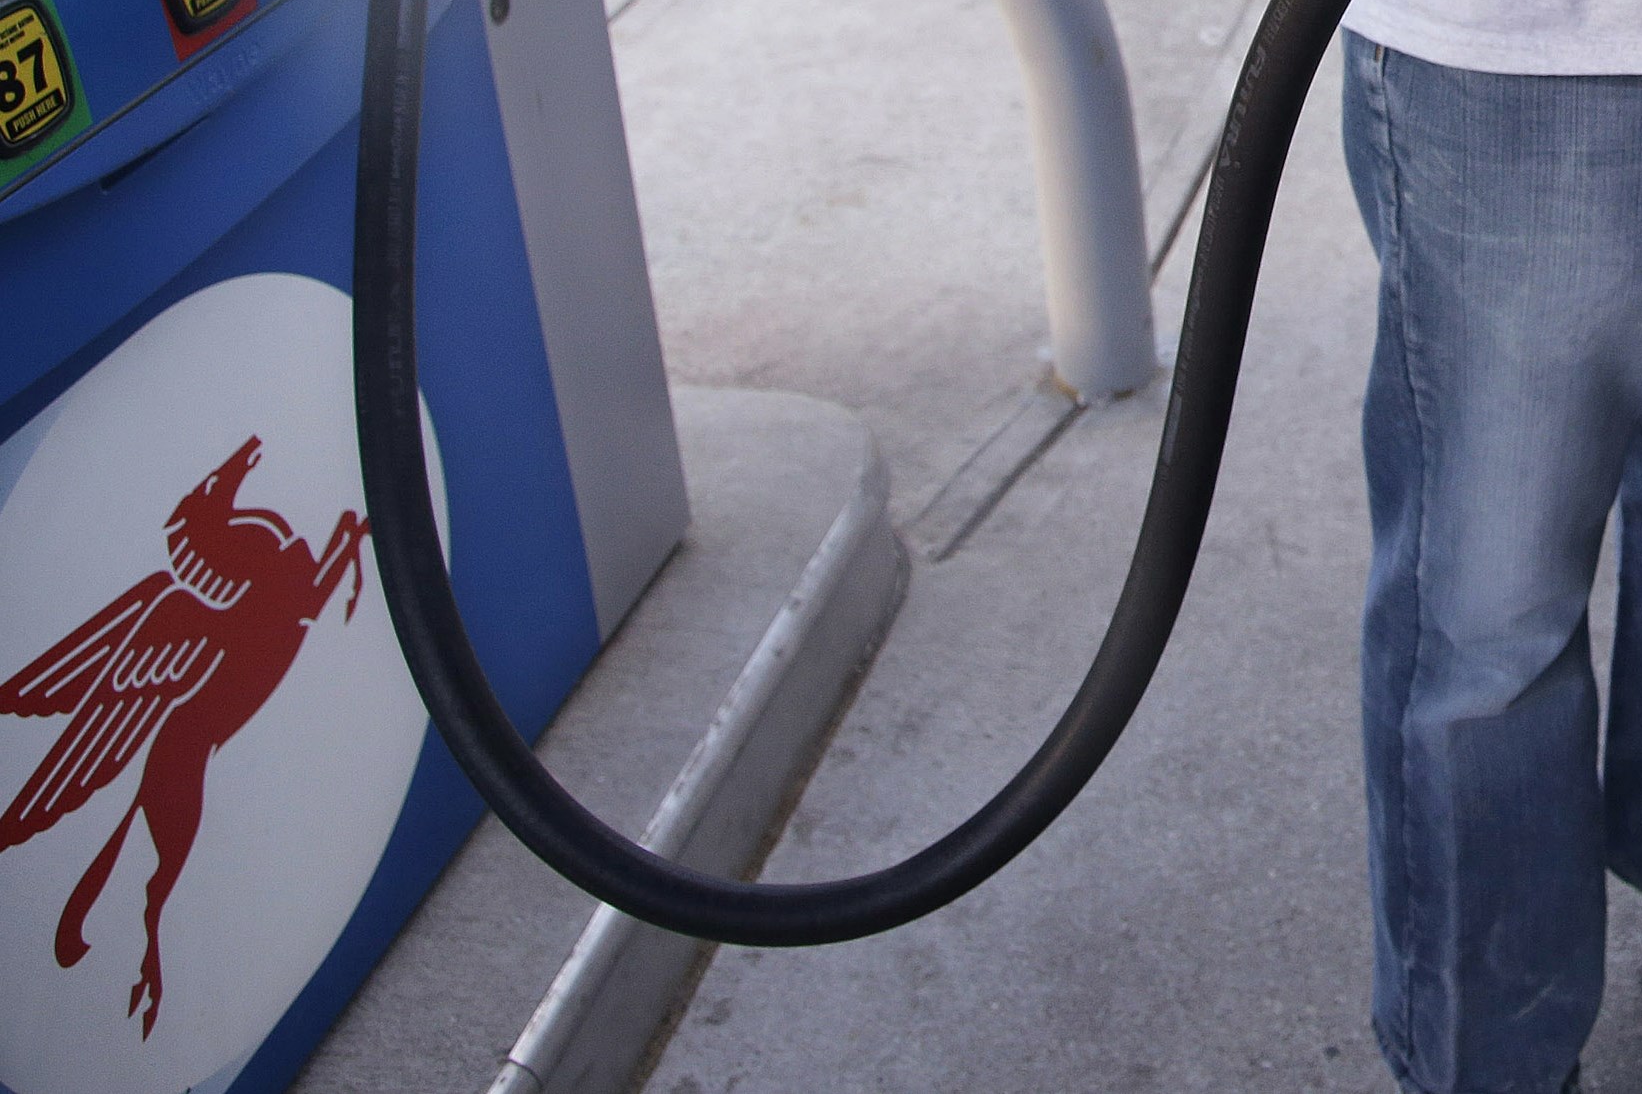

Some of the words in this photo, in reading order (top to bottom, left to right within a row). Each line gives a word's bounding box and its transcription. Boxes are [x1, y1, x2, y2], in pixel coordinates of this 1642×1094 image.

[0, 37, 48, 113] 87
[12, 109, 37, 133] PUSH
[35, 94, 57, 118] HERE
